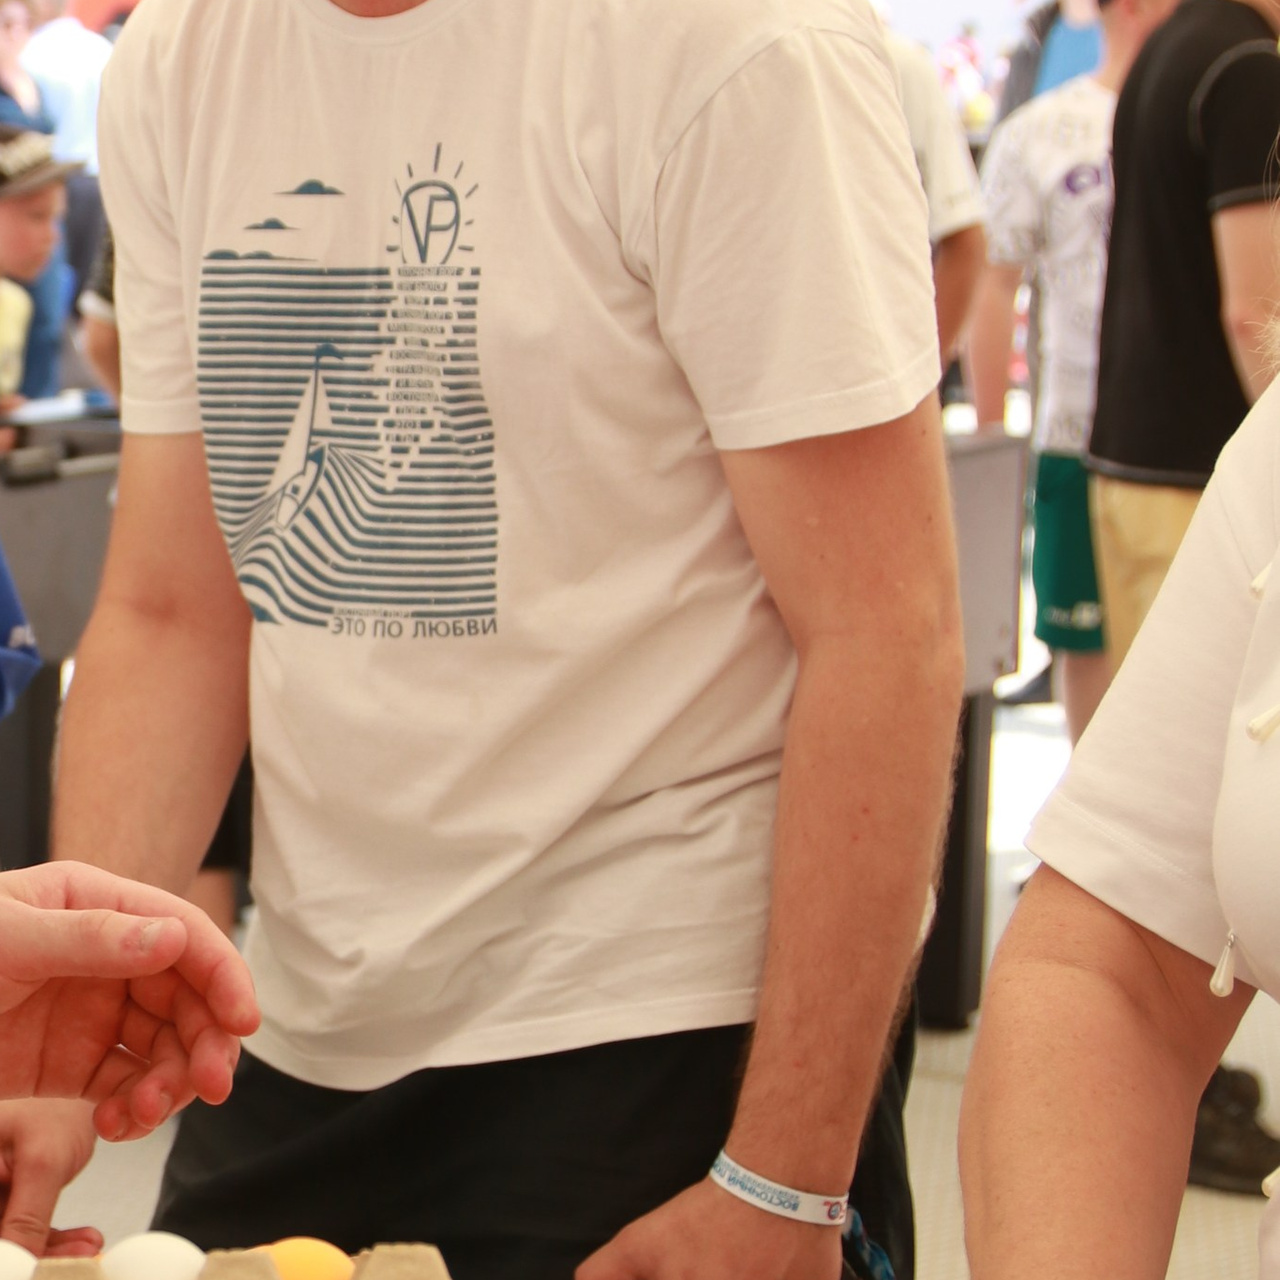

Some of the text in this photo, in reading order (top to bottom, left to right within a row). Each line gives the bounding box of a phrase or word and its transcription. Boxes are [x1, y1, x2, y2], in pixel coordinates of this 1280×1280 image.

[331, 616, 498, 638] ЭТО ПО ЛЮБВИ
